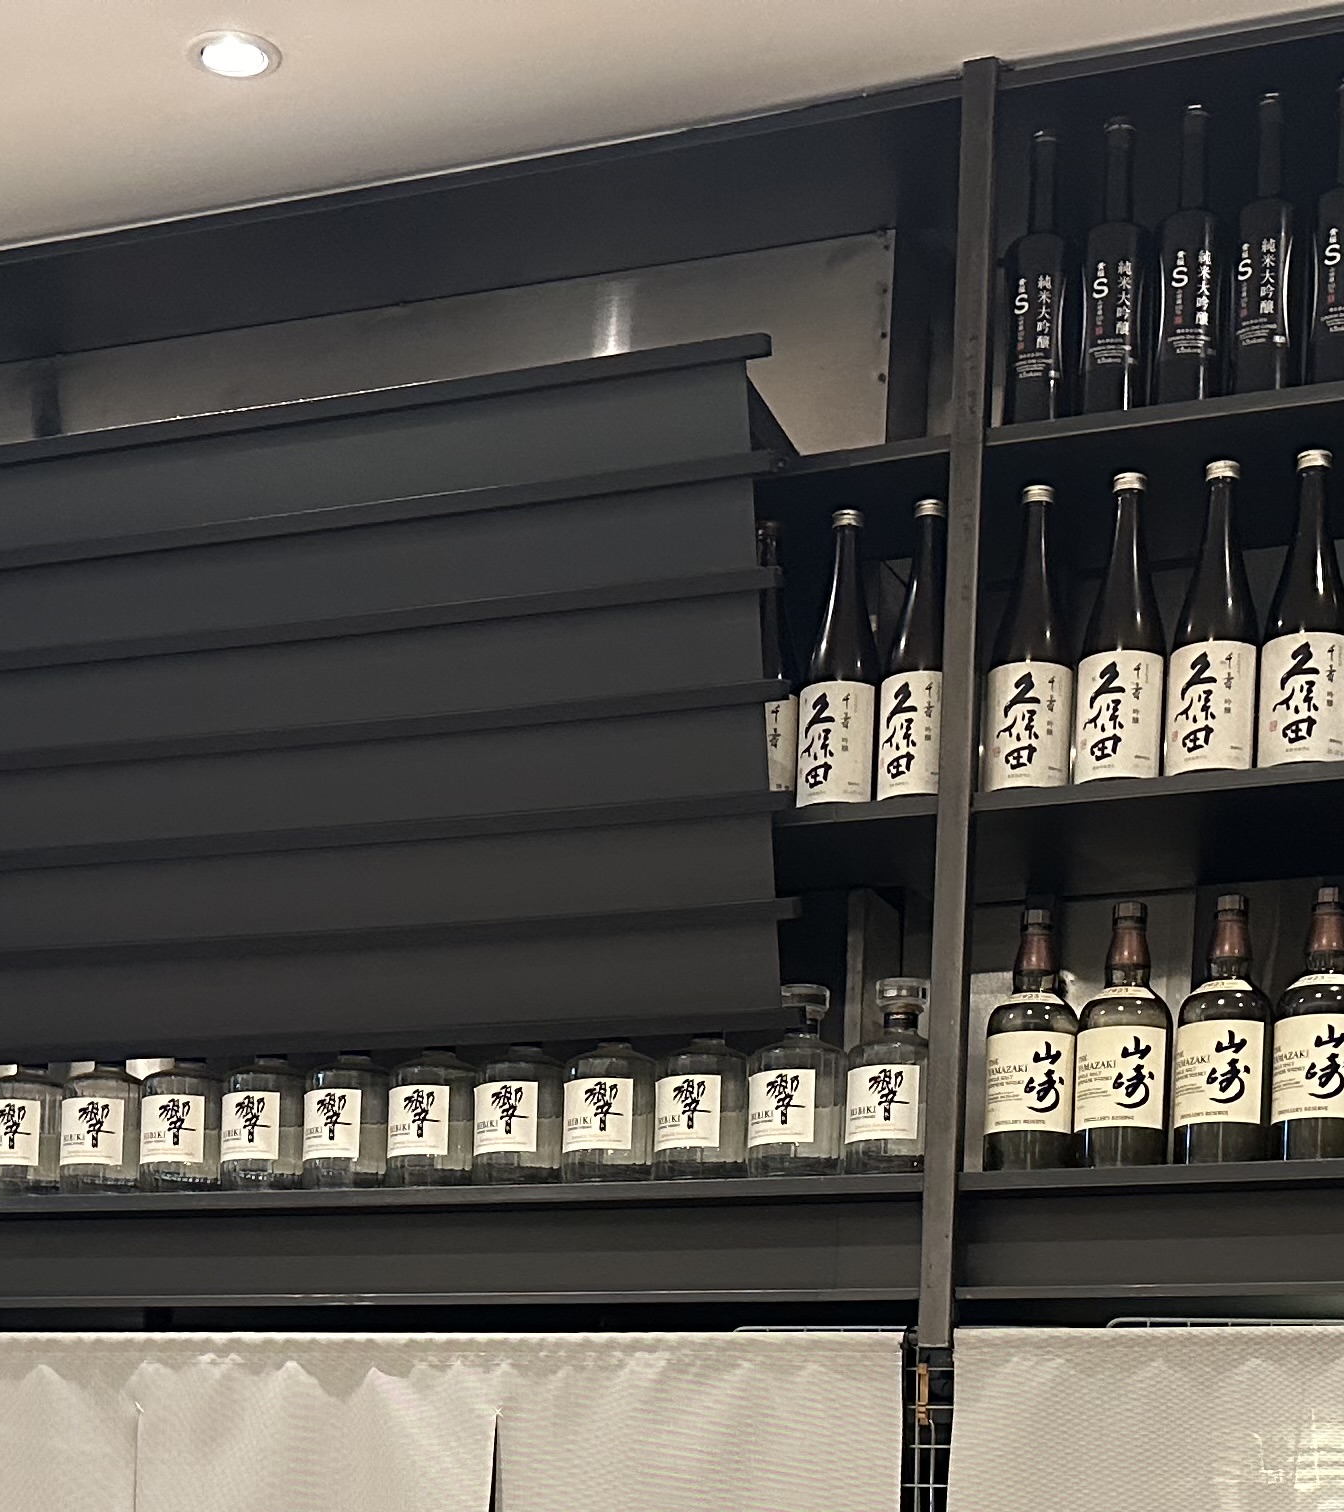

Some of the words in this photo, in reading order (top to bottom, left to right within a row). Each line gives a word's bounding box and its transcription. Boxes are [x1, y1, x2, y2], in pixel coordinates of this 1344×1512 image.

[1172, 267, 1188, 287] S
[1238, 259, 1252, 280] S
[1260, 239, 1275, 313] 純米大吟醸
[1324, 244, 1340, 265] S
[1015, 294, 1028, 314] S
[1116, 261, 1132, 335] 純米大吟醸
[1083, 661, 1125, 761] 久保田
[1174, 651, 1217, 753] 久保田
[1273, 641, 1320, 744] 久保田
[800, 692, 835, 789] 久保田
[882, 682, 917, 779] 久保田
[996, 672, 1040, 770] 久保田
[1024, 1041, 1064, 1113] 山崎
[1113, 1036, 1154, 1109] 山崎
[1206, 1030, 1250, 1104] 山崎
[235, 1095, 270, 1143] 響
[404, 1089, 440, 1138] 響
[492, 1085, 528, 1134] 響
[583, 1082, 623, 1131] 響
[673, 1079, 711, 1129] 響
[762, 1074, 805, 1125] 響
[869, 1069, 909, 1121] 響
[79, 1101, 115, 1148] 響
